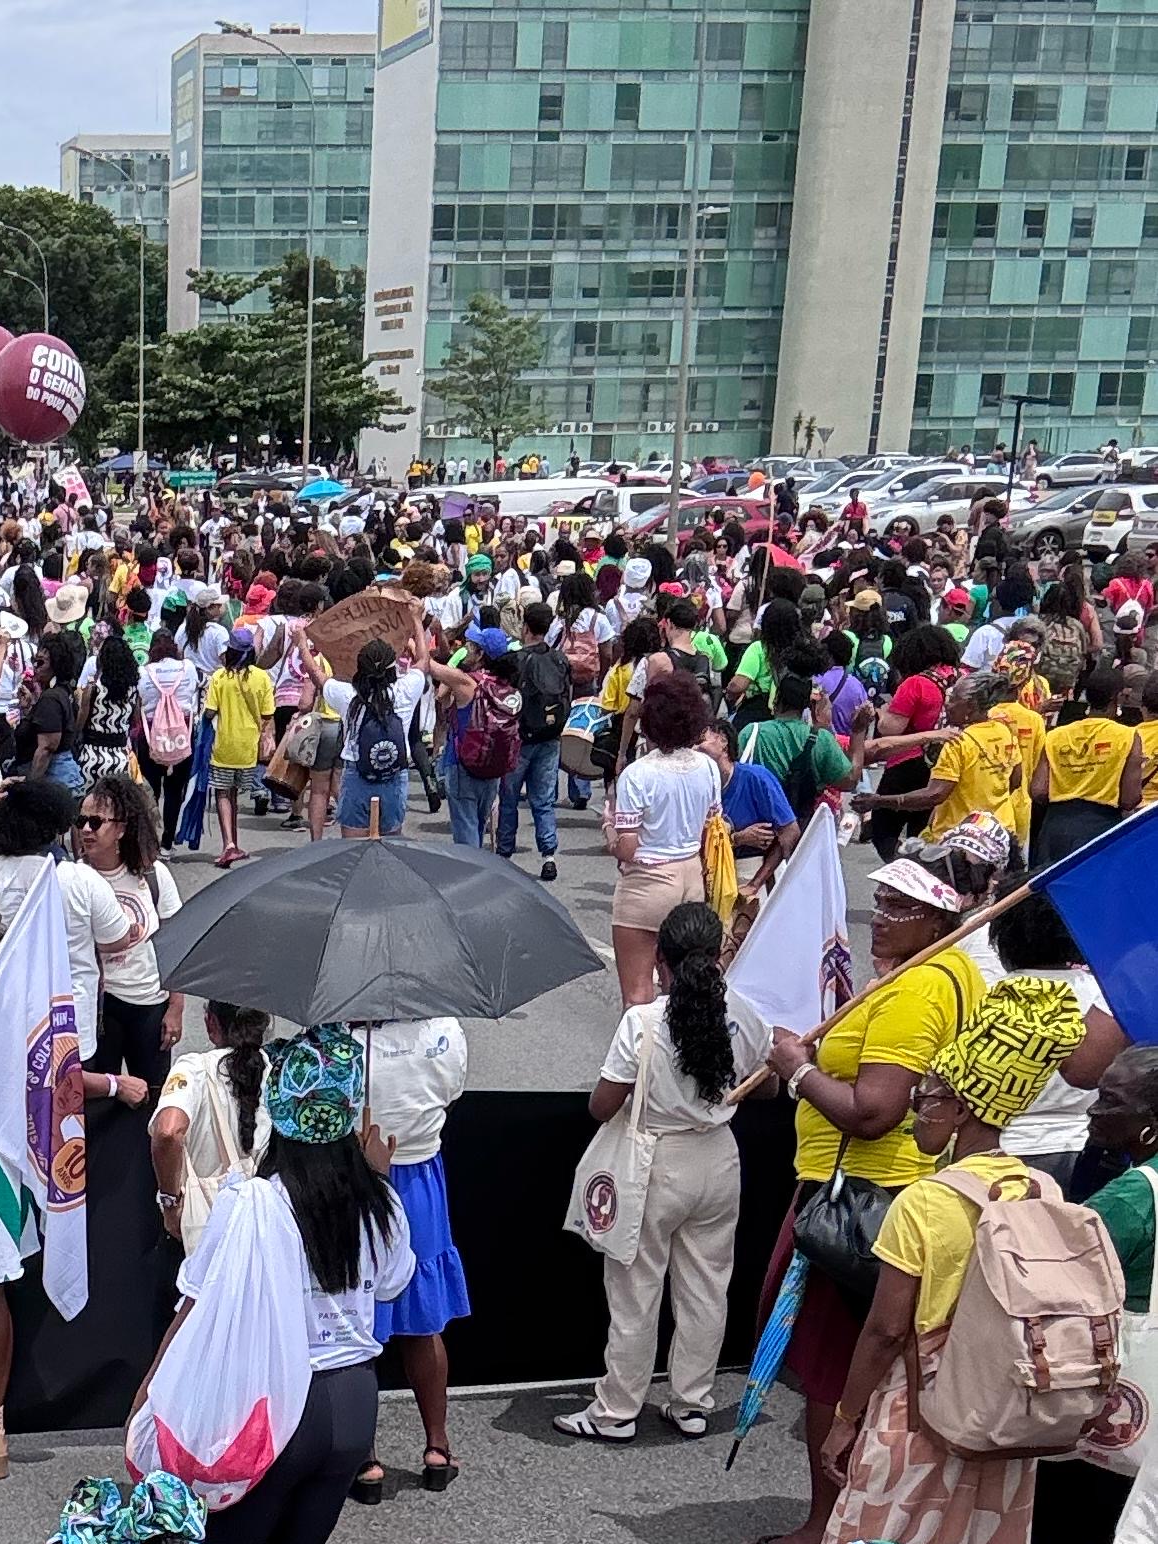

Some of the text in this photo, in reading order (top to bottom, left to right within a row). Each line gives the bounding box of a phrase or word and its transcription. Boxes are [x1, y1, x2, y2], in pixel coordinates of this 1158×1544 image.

[31, 345, 85, 388] CONT
[55, 1167, 73, 1190] ANOS
[65, 1143, 85, 1180] 10
